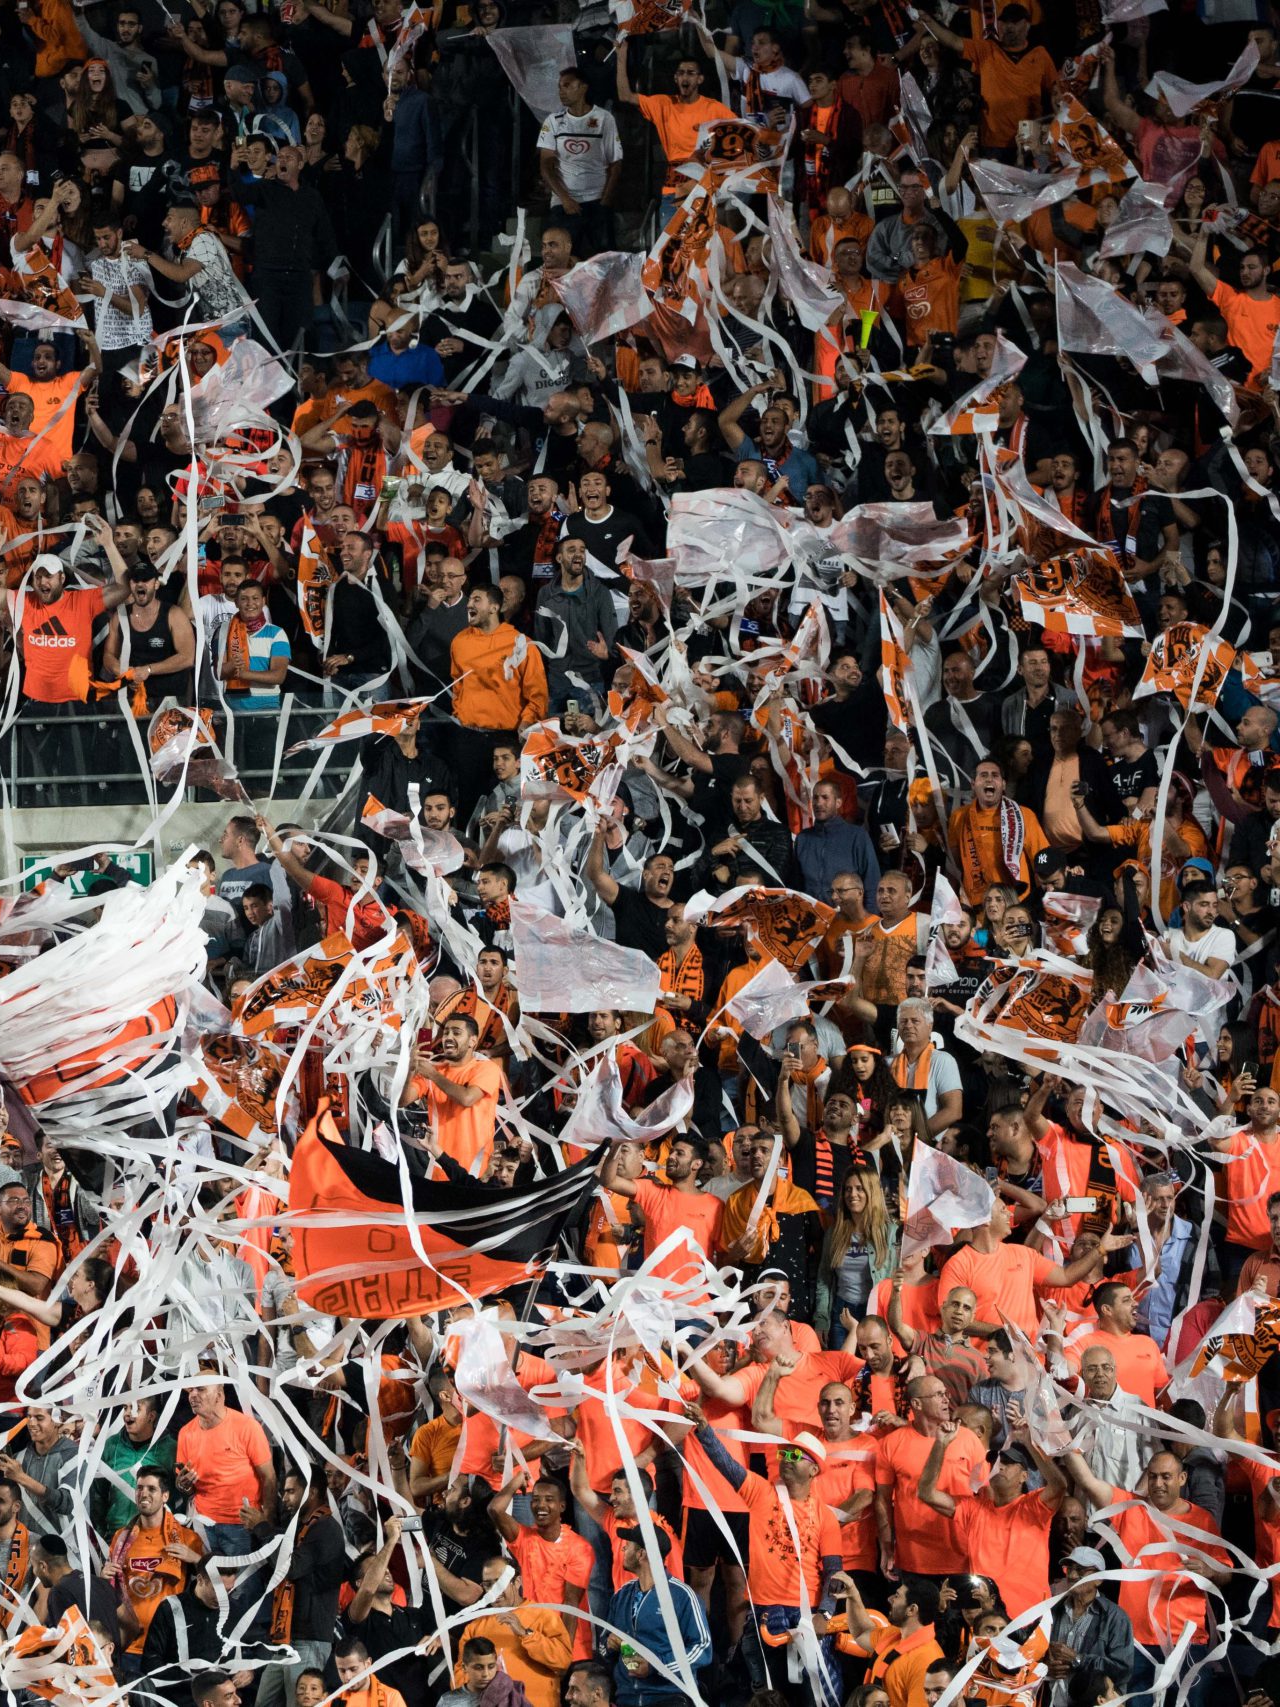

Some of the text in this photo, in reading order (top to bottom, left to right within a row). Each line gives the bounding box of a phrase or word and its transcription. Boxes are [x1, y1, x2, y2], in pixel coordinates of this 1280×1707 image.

[722, 134, 744, 156] 9
[28, 635, 76, 648] adidas
[959, 977, 979, 988] סופר
